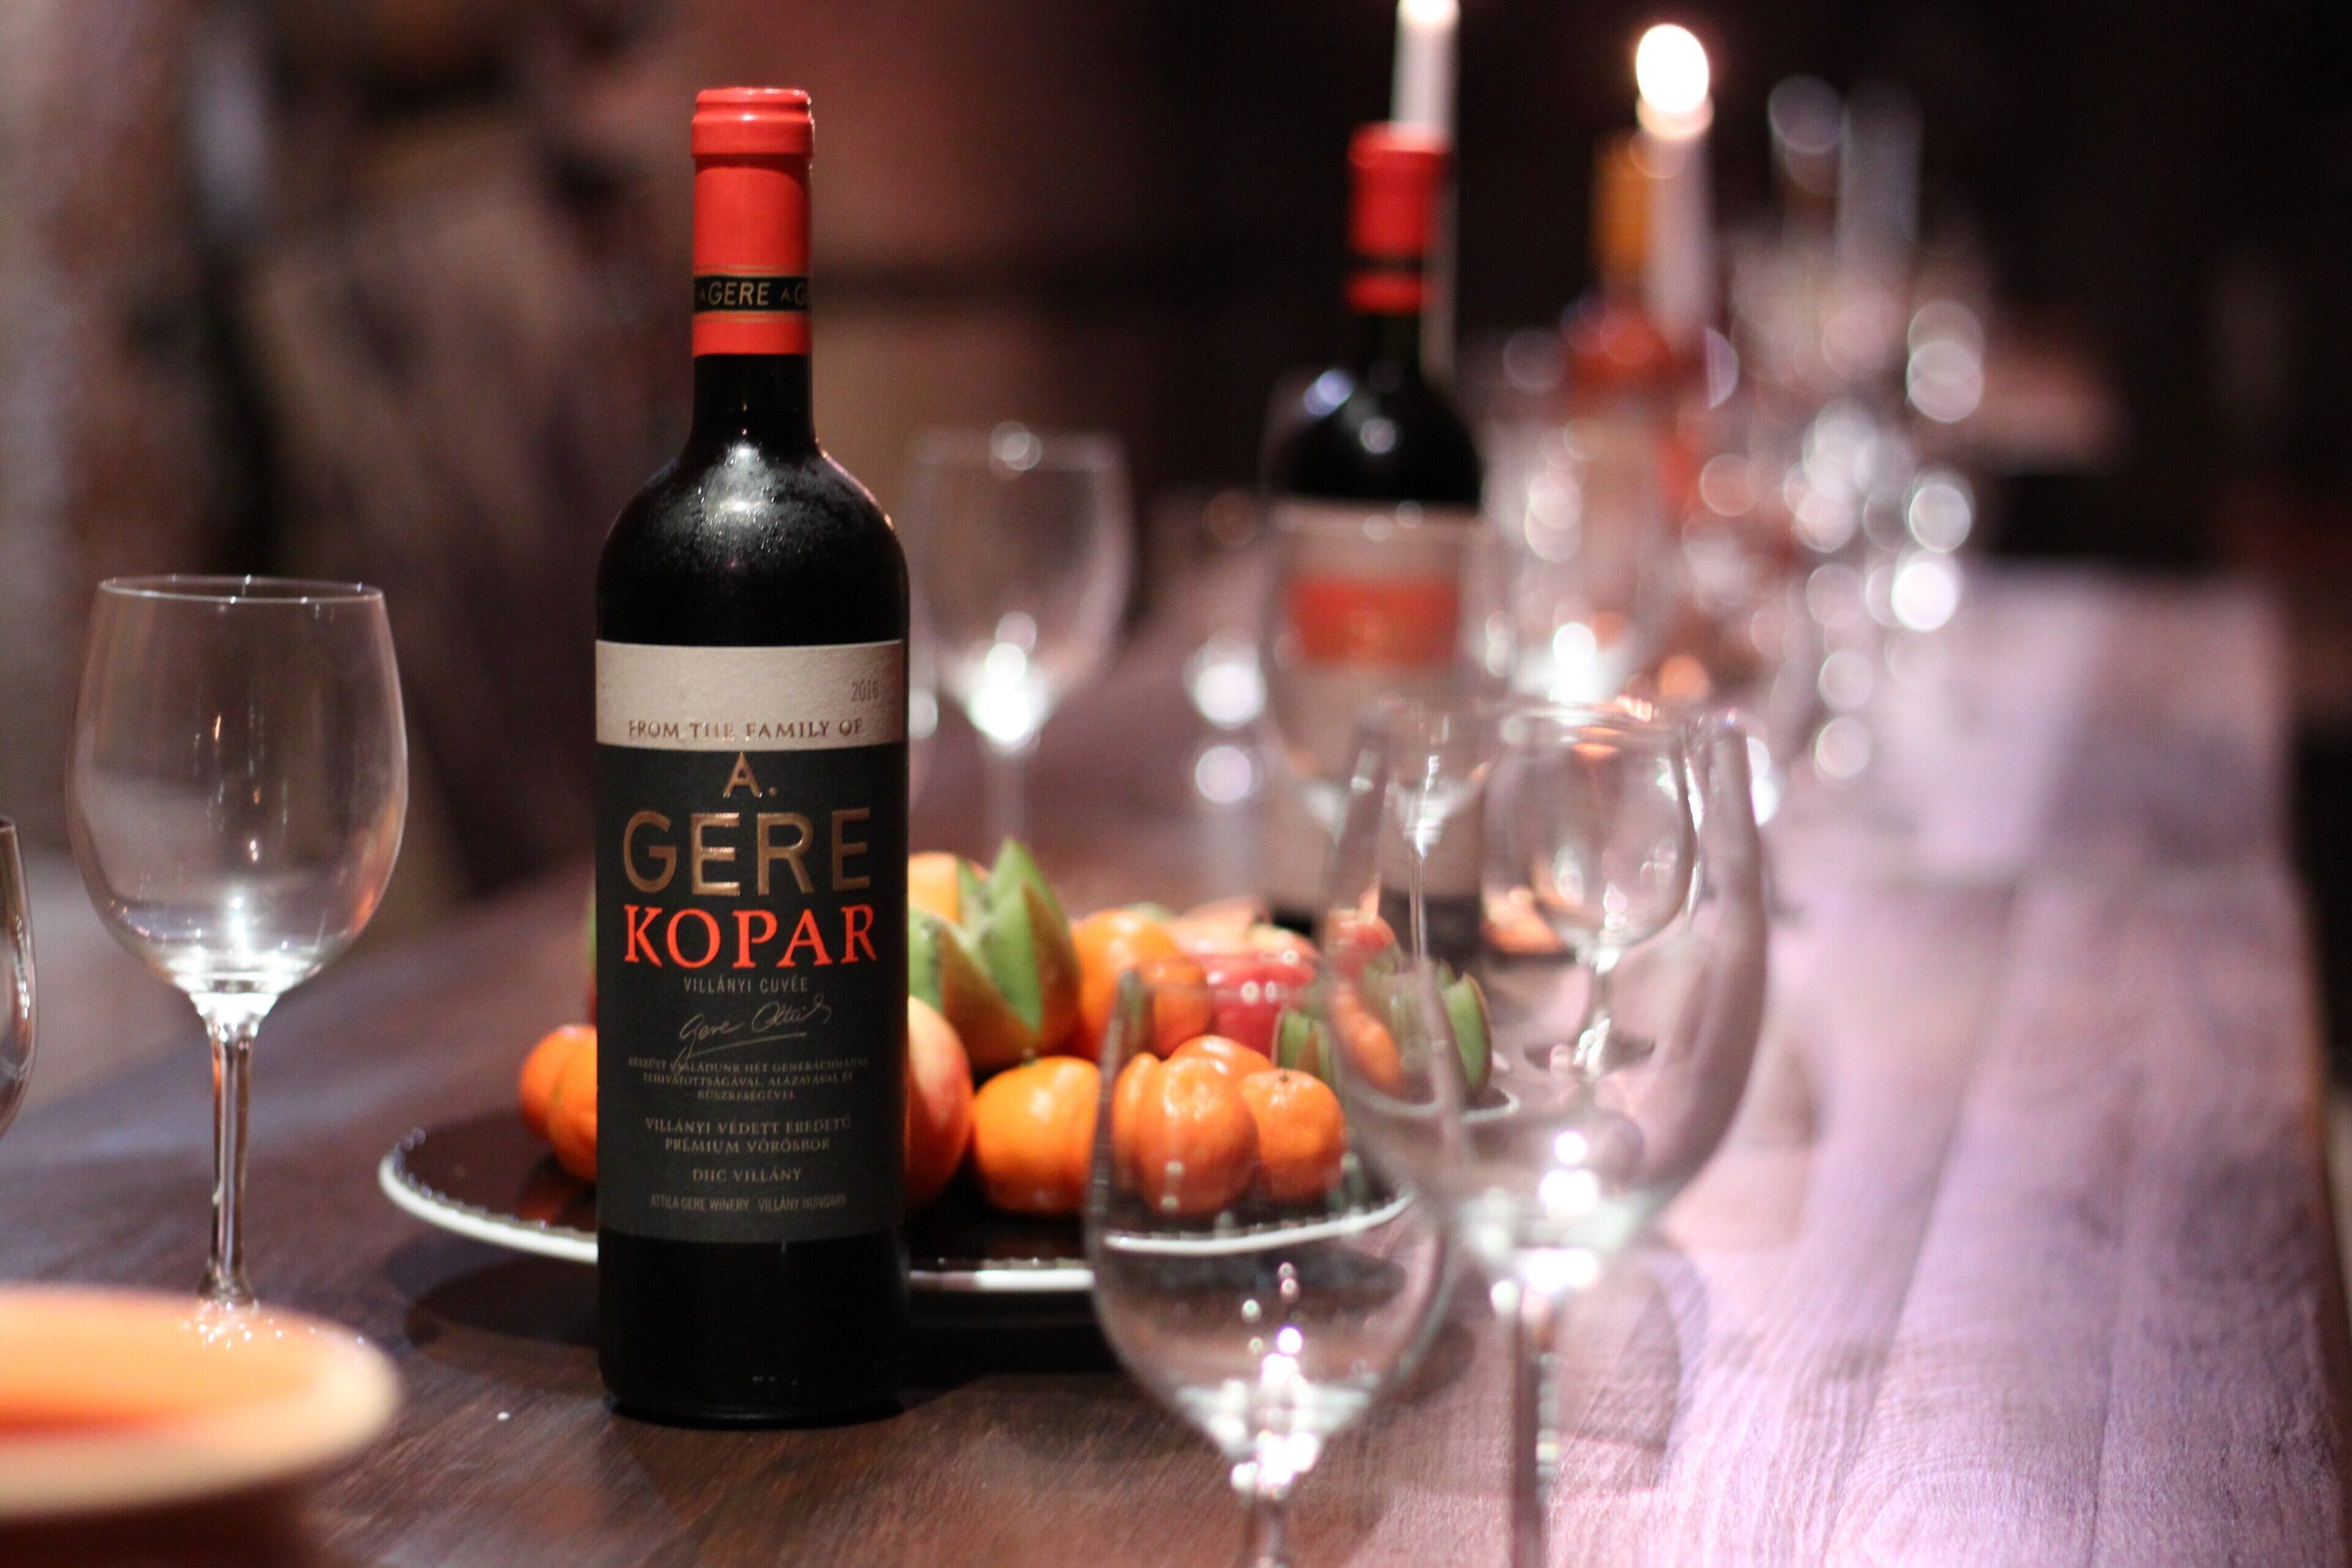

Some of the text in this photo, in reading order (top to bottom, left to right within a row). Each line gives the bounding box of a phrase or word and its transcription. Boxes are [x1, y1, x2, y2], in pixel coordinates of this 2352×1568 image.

[708, 281, 771, 306] GERE
[629, 717, 862, 740] FROM THE FAMILY OF
[723, 751, 777, 798] A.
[623, 807, 870, 895] GERE
[624, 903, 877, 969] KOPAR
[684, 974, 808, 994] VILLÁNYI CUVÉE
[646, 1117, 710, 1134] VILLÁNYI
[718, 1117, 780, 1135] VÉDETT
[665, 1137, 739, 1154] PRÉMIUM
[733, 1166, 802, 1183] VILLÁNY
